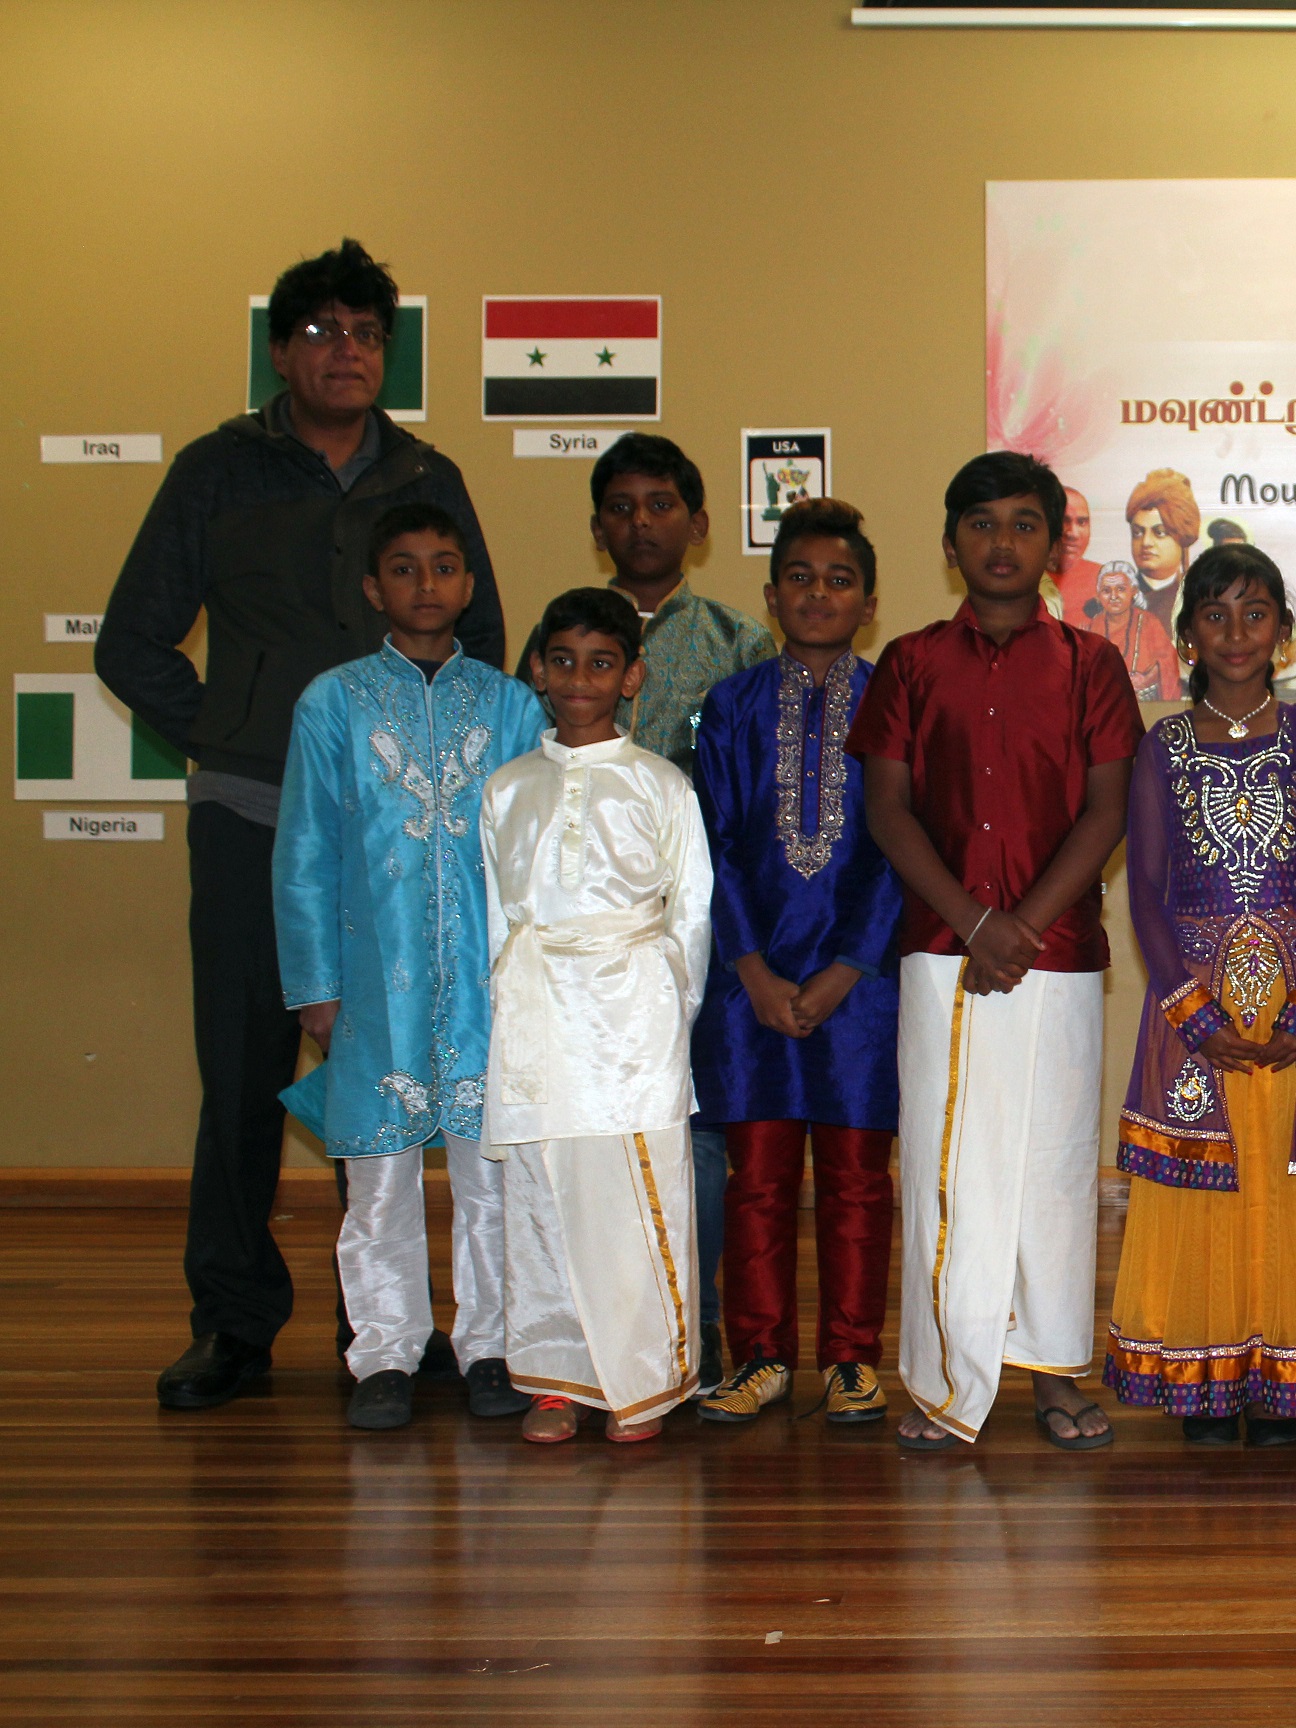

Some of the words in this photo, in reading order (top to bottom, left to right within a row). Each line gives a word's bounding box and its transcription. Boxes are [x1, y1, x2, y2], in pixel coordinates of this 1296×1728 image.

[82, 439, 120, 458] Iraq
[549, 433, 597, 452] Syria
[772, 441, 800, 453] USA
[69, 817, 138, 836] Nigeria
